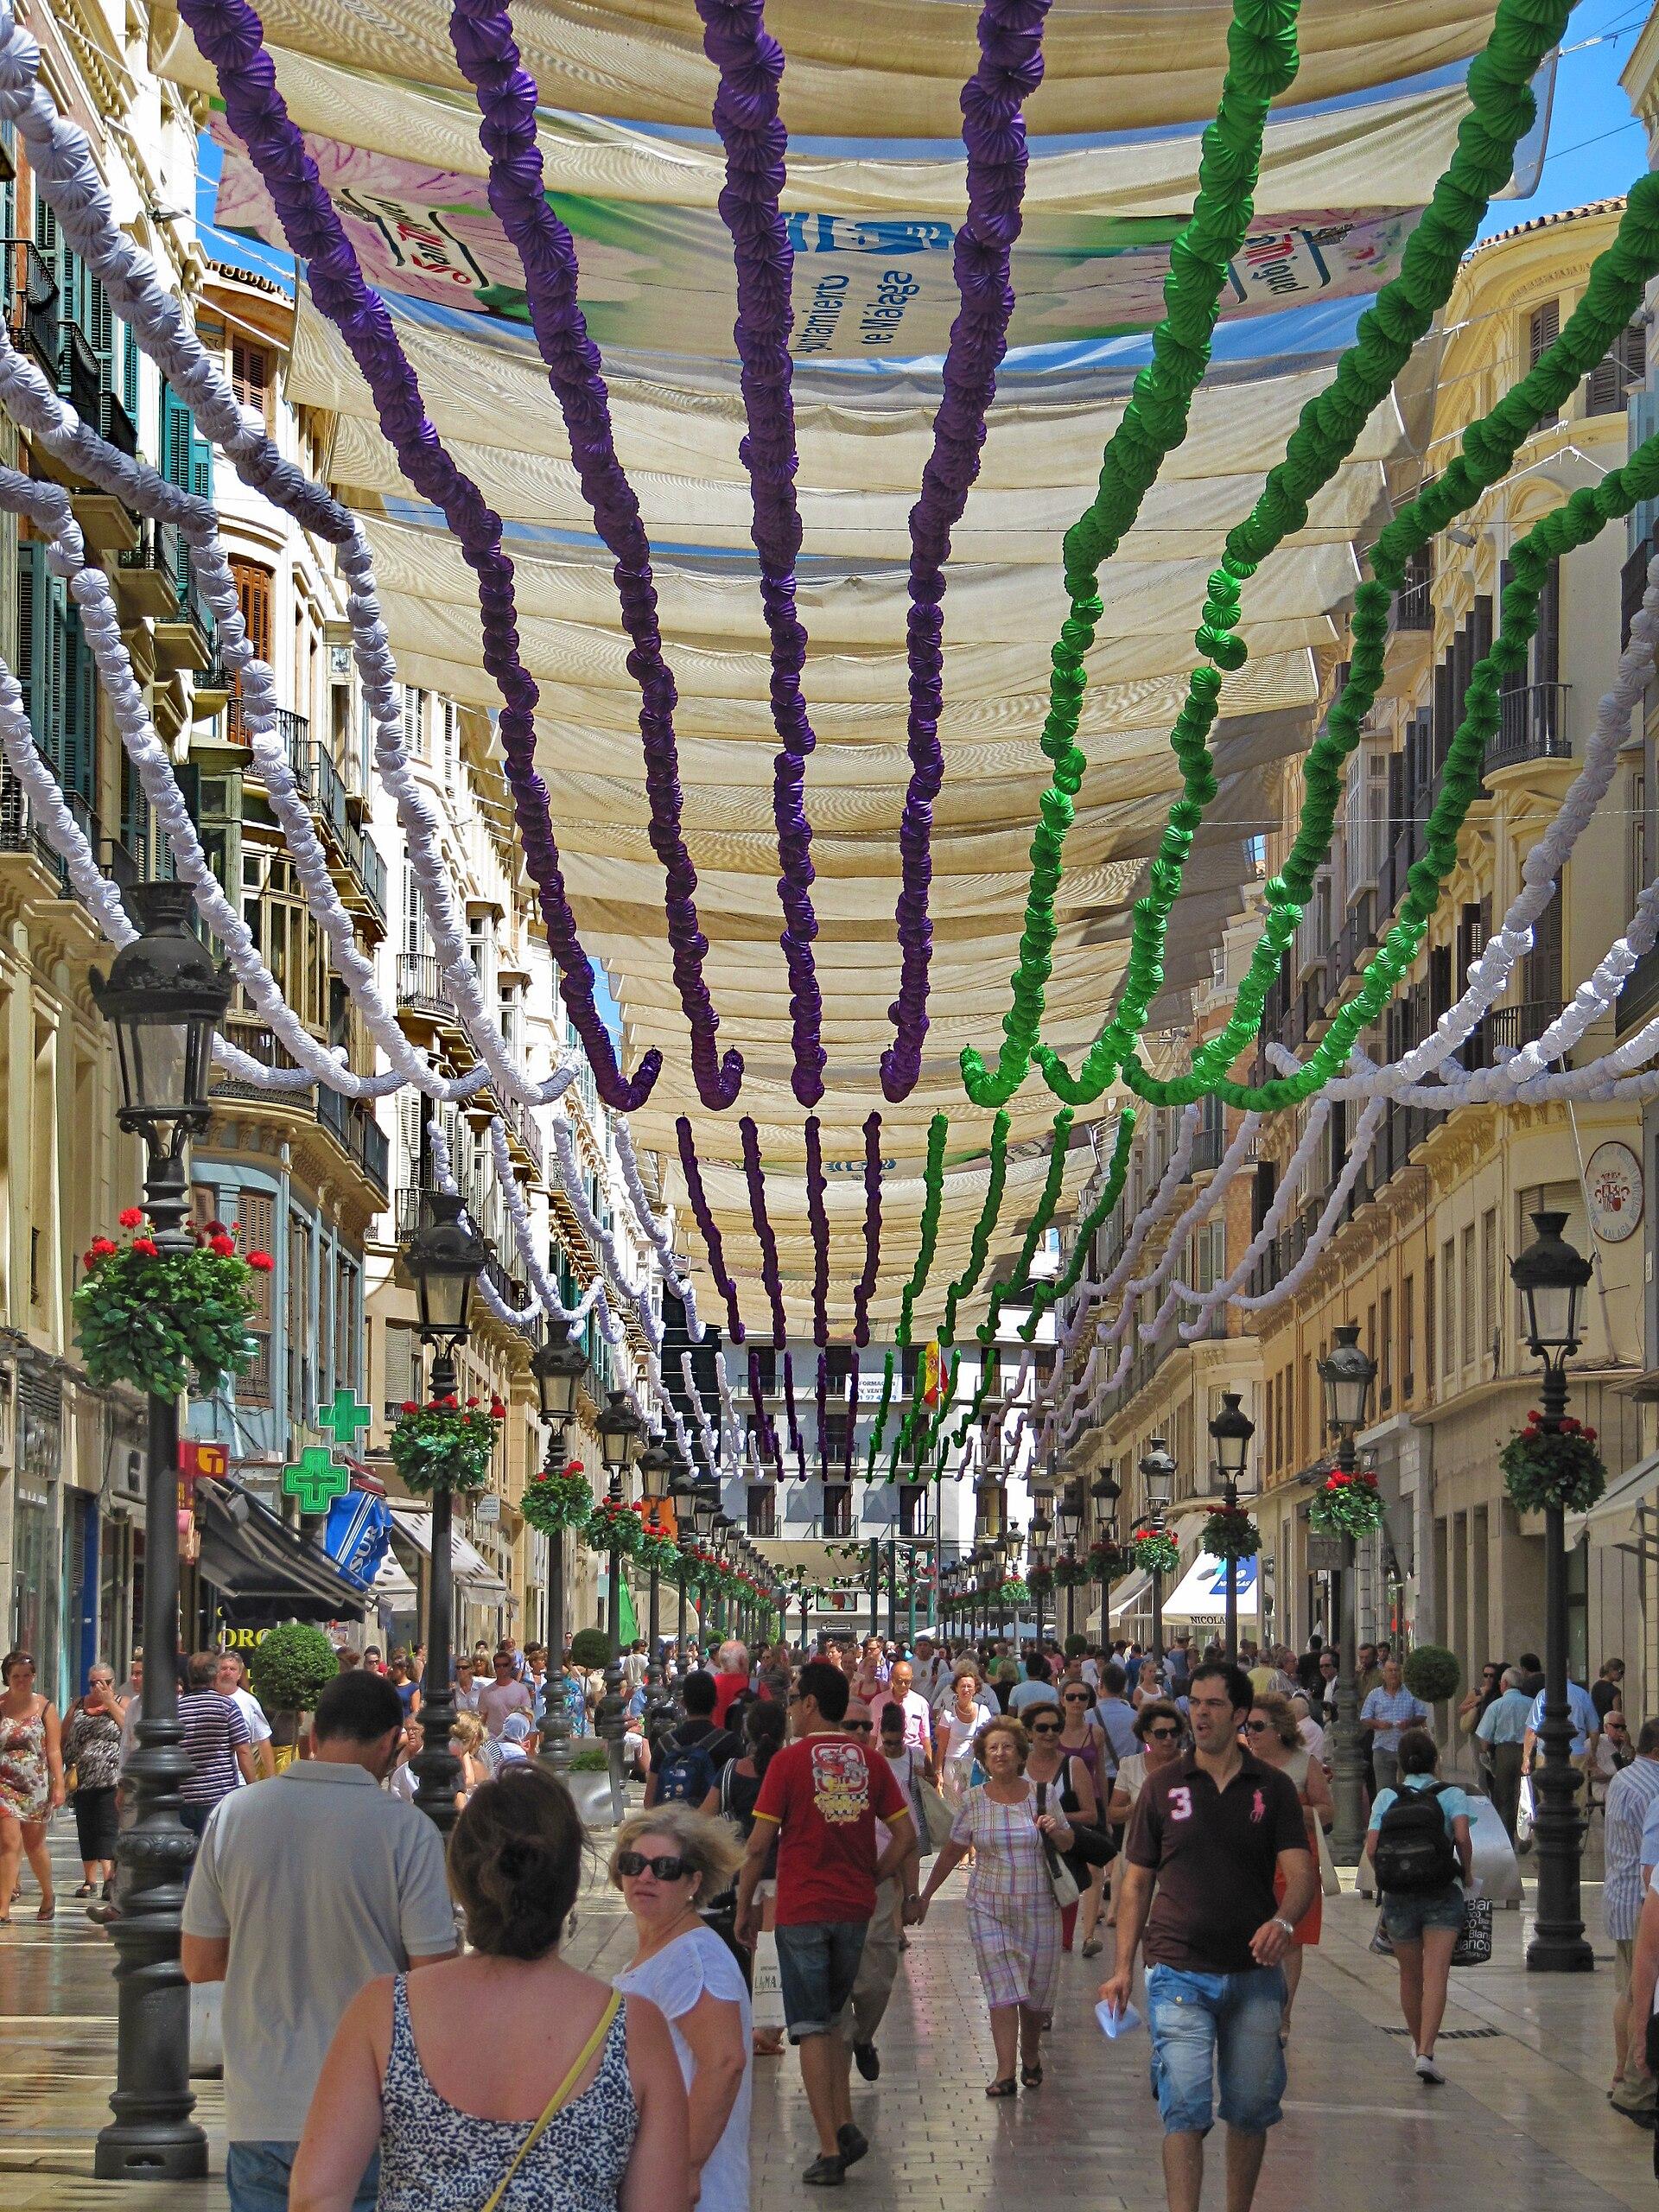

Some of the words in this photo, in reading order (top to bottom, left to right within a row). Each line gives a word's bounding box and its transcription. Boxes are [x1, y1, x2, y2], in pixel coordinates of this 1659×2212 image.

[788, 274, 850, 353] yuntamient
[859, 270, 919, 330] Málaga
[1190, 1616, 1227, 1624] NICOLA
[1168, 1786, 1192, 1821] 3
